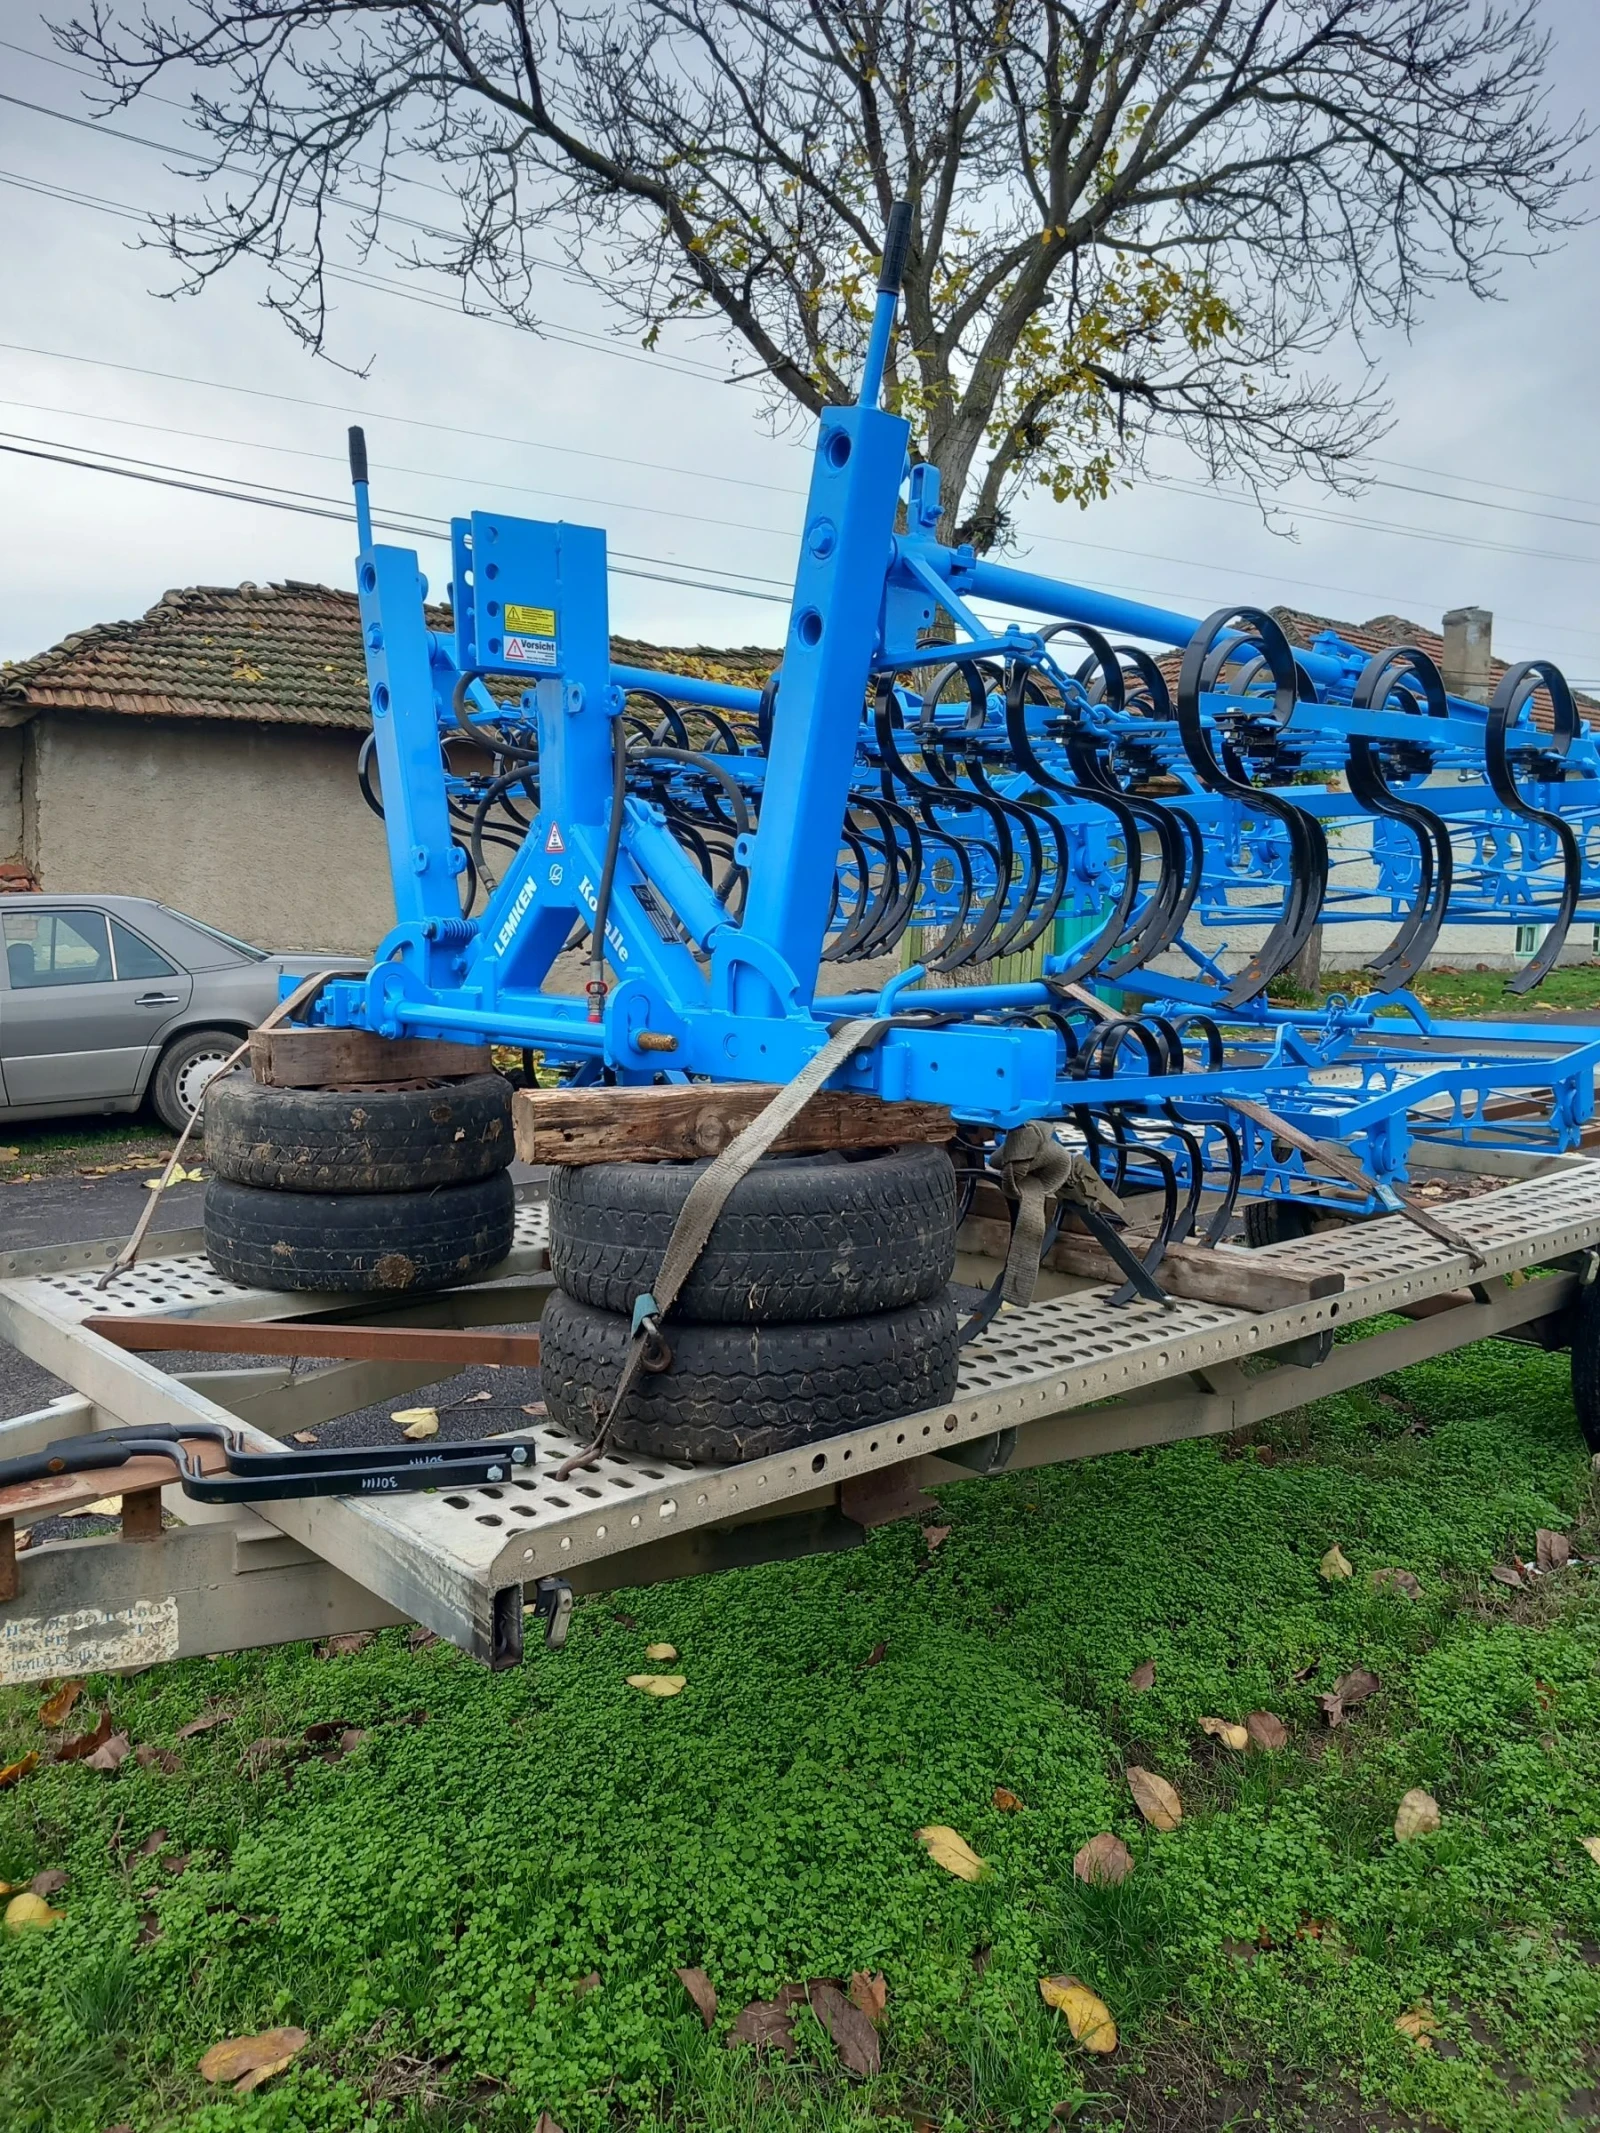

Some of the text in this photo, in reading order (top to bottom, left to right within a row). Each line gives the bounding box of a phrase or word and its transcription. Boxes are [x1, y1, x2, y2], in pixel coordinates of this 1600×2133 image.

[521, 639, 554, 651] Vorsicht
[493, 875, 539, 957] LEMKEN
[578, 875, 629, 963] Koalle
